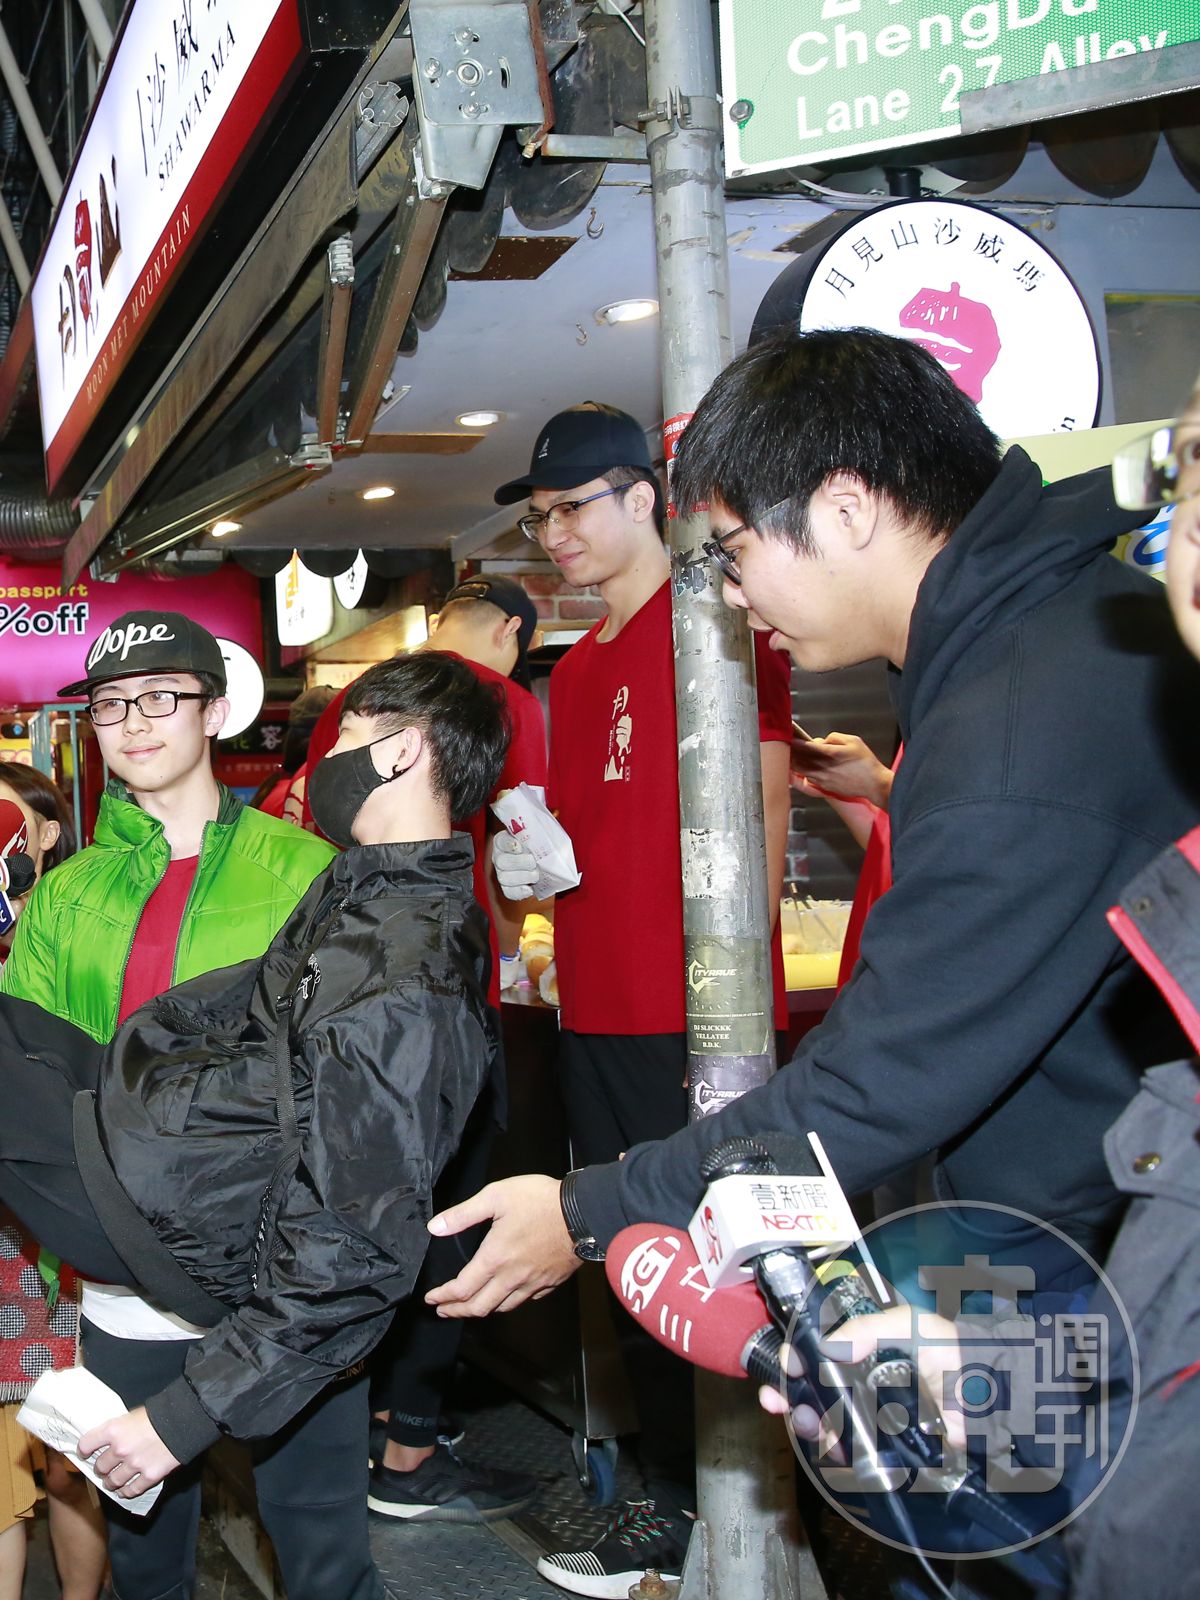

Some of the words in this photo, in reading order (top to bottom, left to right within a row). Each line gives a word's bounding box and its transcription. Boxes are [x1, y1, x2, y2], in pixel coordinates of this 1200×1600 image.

[158, 20, 236, 191] SHAWARMA
[797, 87, 910, 140] Lane
[1038, 30, 1169, 88] Alley
[86, 359, 109, 405] MOON
[111, 317, 129, 356] MET
[132, 203, 192, 325] MOUNTAIN
[824, 216, 1047, 301] 月見山沙威瑪
[750, 1182, 828, 1211] 壹新聞
